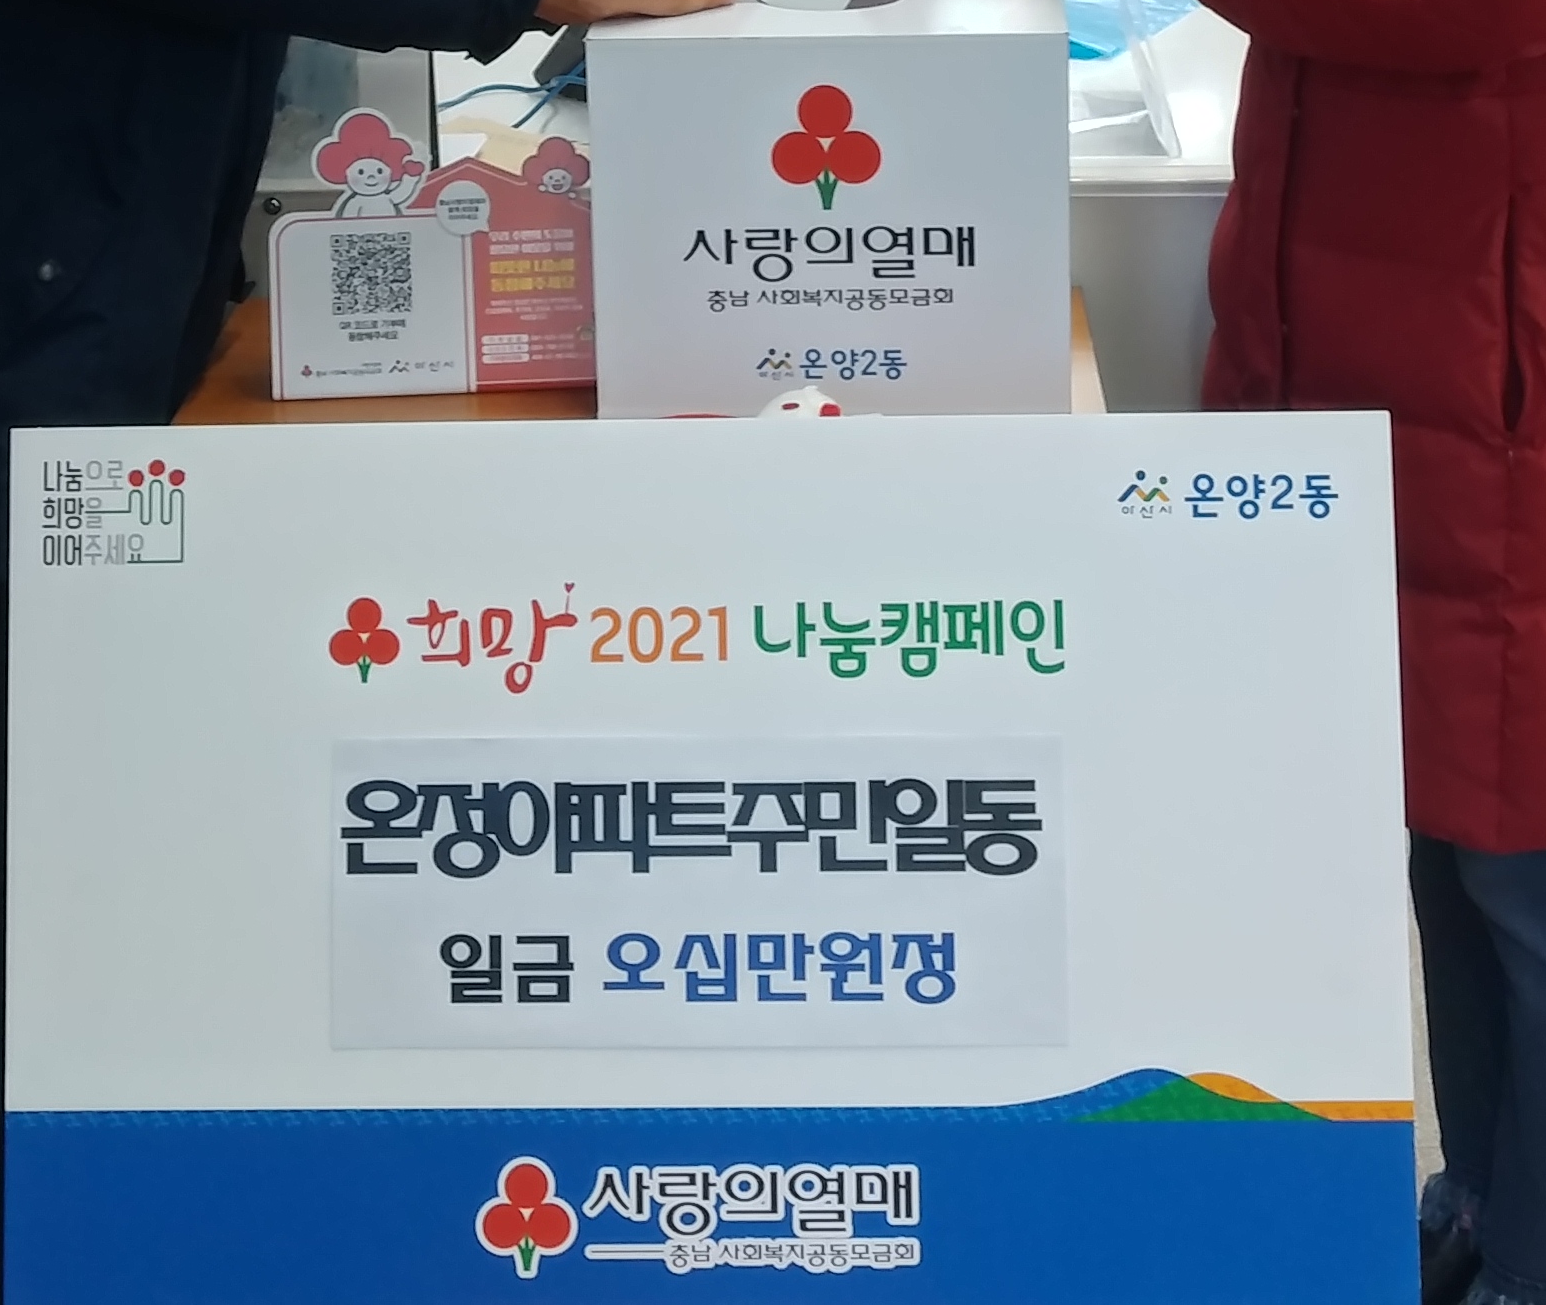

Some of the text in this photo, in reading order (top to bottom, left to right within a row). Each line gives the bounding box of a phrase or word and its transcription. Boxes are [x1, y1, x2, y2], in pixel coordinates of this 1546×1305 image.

[682, 225, 976, 282] 사랑의열매
[707, 287, 954, 312] 충남 사회복지공동모금회
[799, 348, 908, 381] 온양2동
[43, 460, 124, 492] 나눔으로
[42, 496, 103, 529] 희망을
[1121, 505, 1172, 519] 아산시
[1184, 473, 1339, 520] 온양2동
[42, 533, 145, 567] 이어주세요
[407, 599, 1066, 694] 희망 2021 나눔캠페인
[339, 778, 1043, 879] 온정아파트주민일동
[439, 930, 957, 1005] 일금 오십만원정
[588, 1167, 916, 1235] 사랑의열매
[668, 1243, 915, 1268] 충남 사회복지공동모금회
